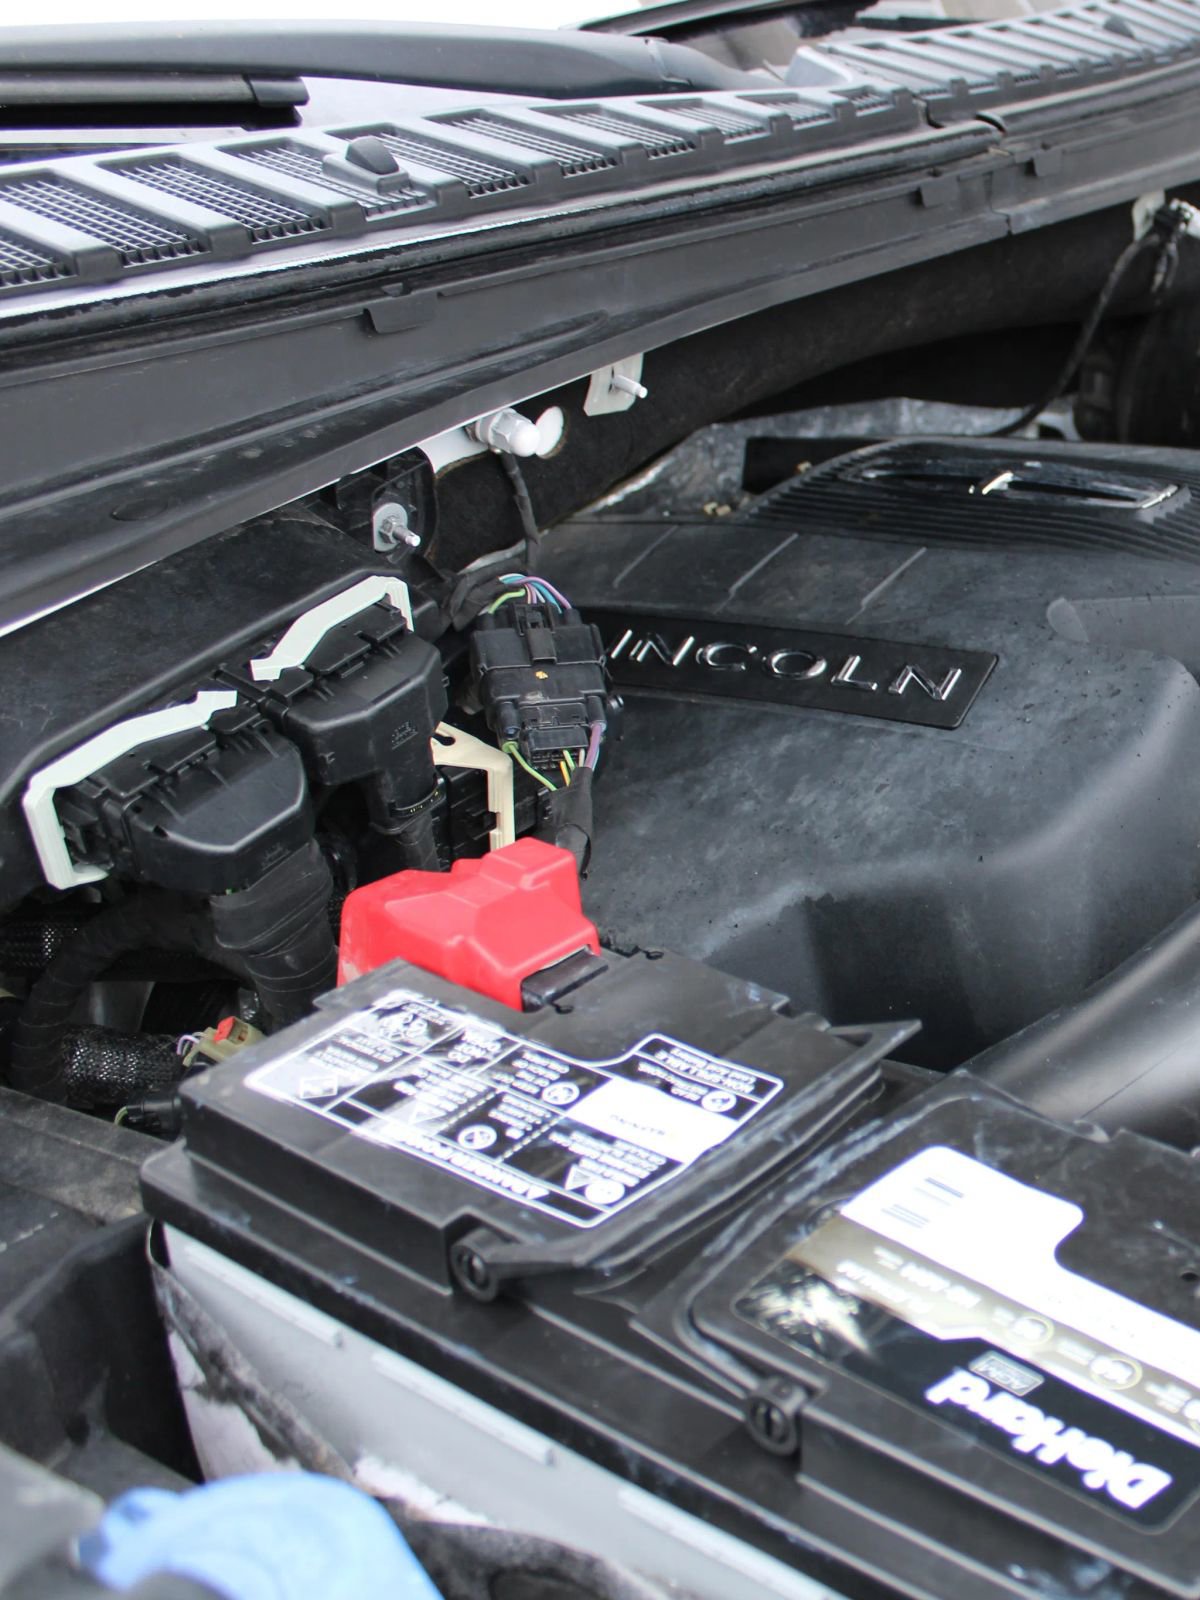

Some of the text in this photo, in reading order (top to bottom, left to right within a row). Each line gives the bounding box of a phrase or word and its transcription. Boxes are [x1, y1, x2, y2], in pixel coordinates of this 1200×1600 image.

[610, 629, 962, 700] INCOLN
[448, 1051, 471, 1063] DO
[454, 1043, 484, 1058] NOT
[654, 1050, 754, 1093] NON-SPILLABLE
[705, 1063, 730, 1078] Acid
[926, 1367, 1171, 1509] DieHard
